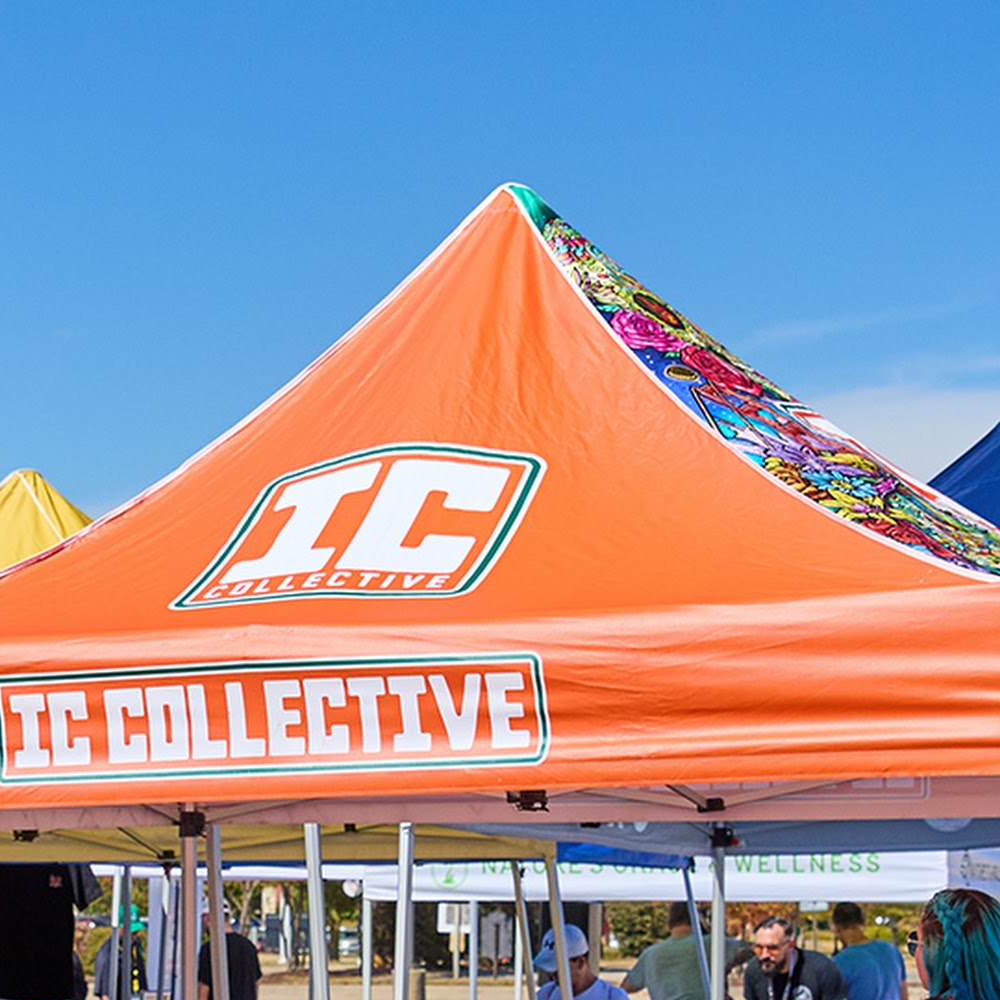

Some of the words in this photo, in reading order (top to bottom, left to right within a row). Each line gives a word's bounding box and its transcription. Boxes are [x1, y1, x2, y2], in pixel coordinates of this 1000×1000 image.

[219, 459, 511, 584] IC
[203, 572, 451, 599] COLLECTIVE
[9, 691, 90, 768] IC
[103, 672, 531, 763] COLLECTIVE
[733, 852, 881, 873] WELLNESS
